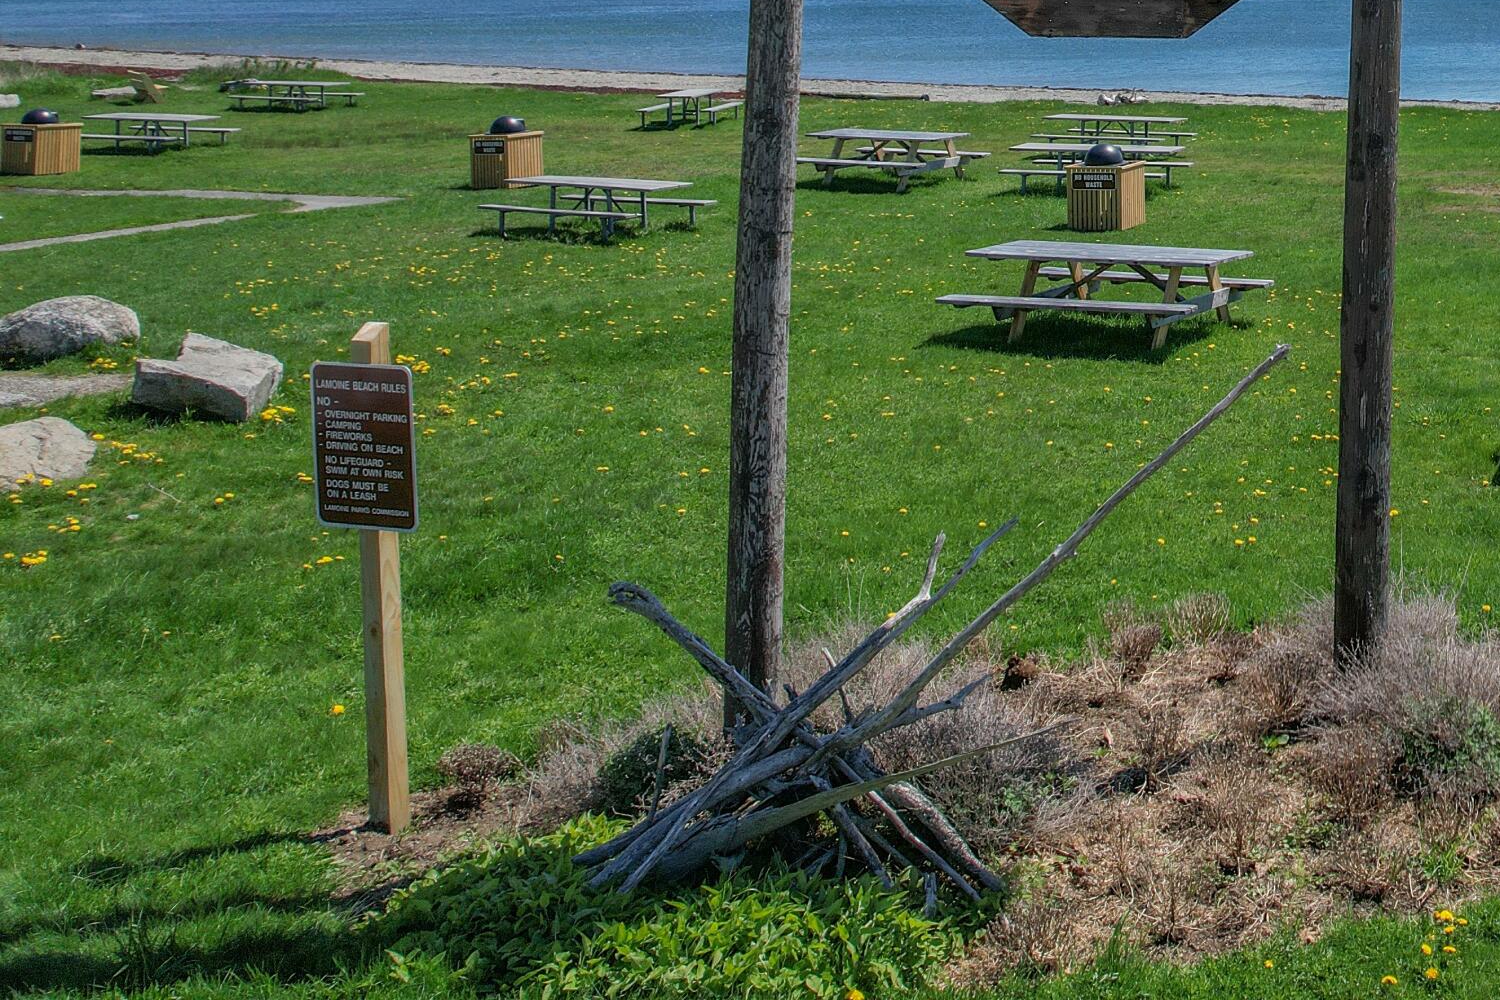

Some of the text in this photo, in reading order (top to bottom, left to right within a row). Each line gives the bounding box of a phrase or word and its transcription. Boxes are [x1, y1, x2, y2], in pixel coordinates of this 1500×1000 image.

[315, 379, 407, 394] LAMOINE BEACH RULES
[316, 396, 331, 406] NO
[324, 409, 370, 421] OVERNIGHT
[373, 412, 408, 423] PARKING
[325, 420, 362, 430] CAMPING
[325, 430, 373, 442] FIREWORKS
[325, 441, 358, 451] DRIVING
[360, 444, 374, 453] ON
[375, 445, 404, 455] BEACH
[324, 455, 337, 464] NO
[339, 456, 384, 467] LIFEGUARD
[325, 465, 404, 480] SWIM AT OWN RISK
[326, 479, 389, 492] DOGS MUST BE
[326, 489, 377, 501] ON A LEASH
